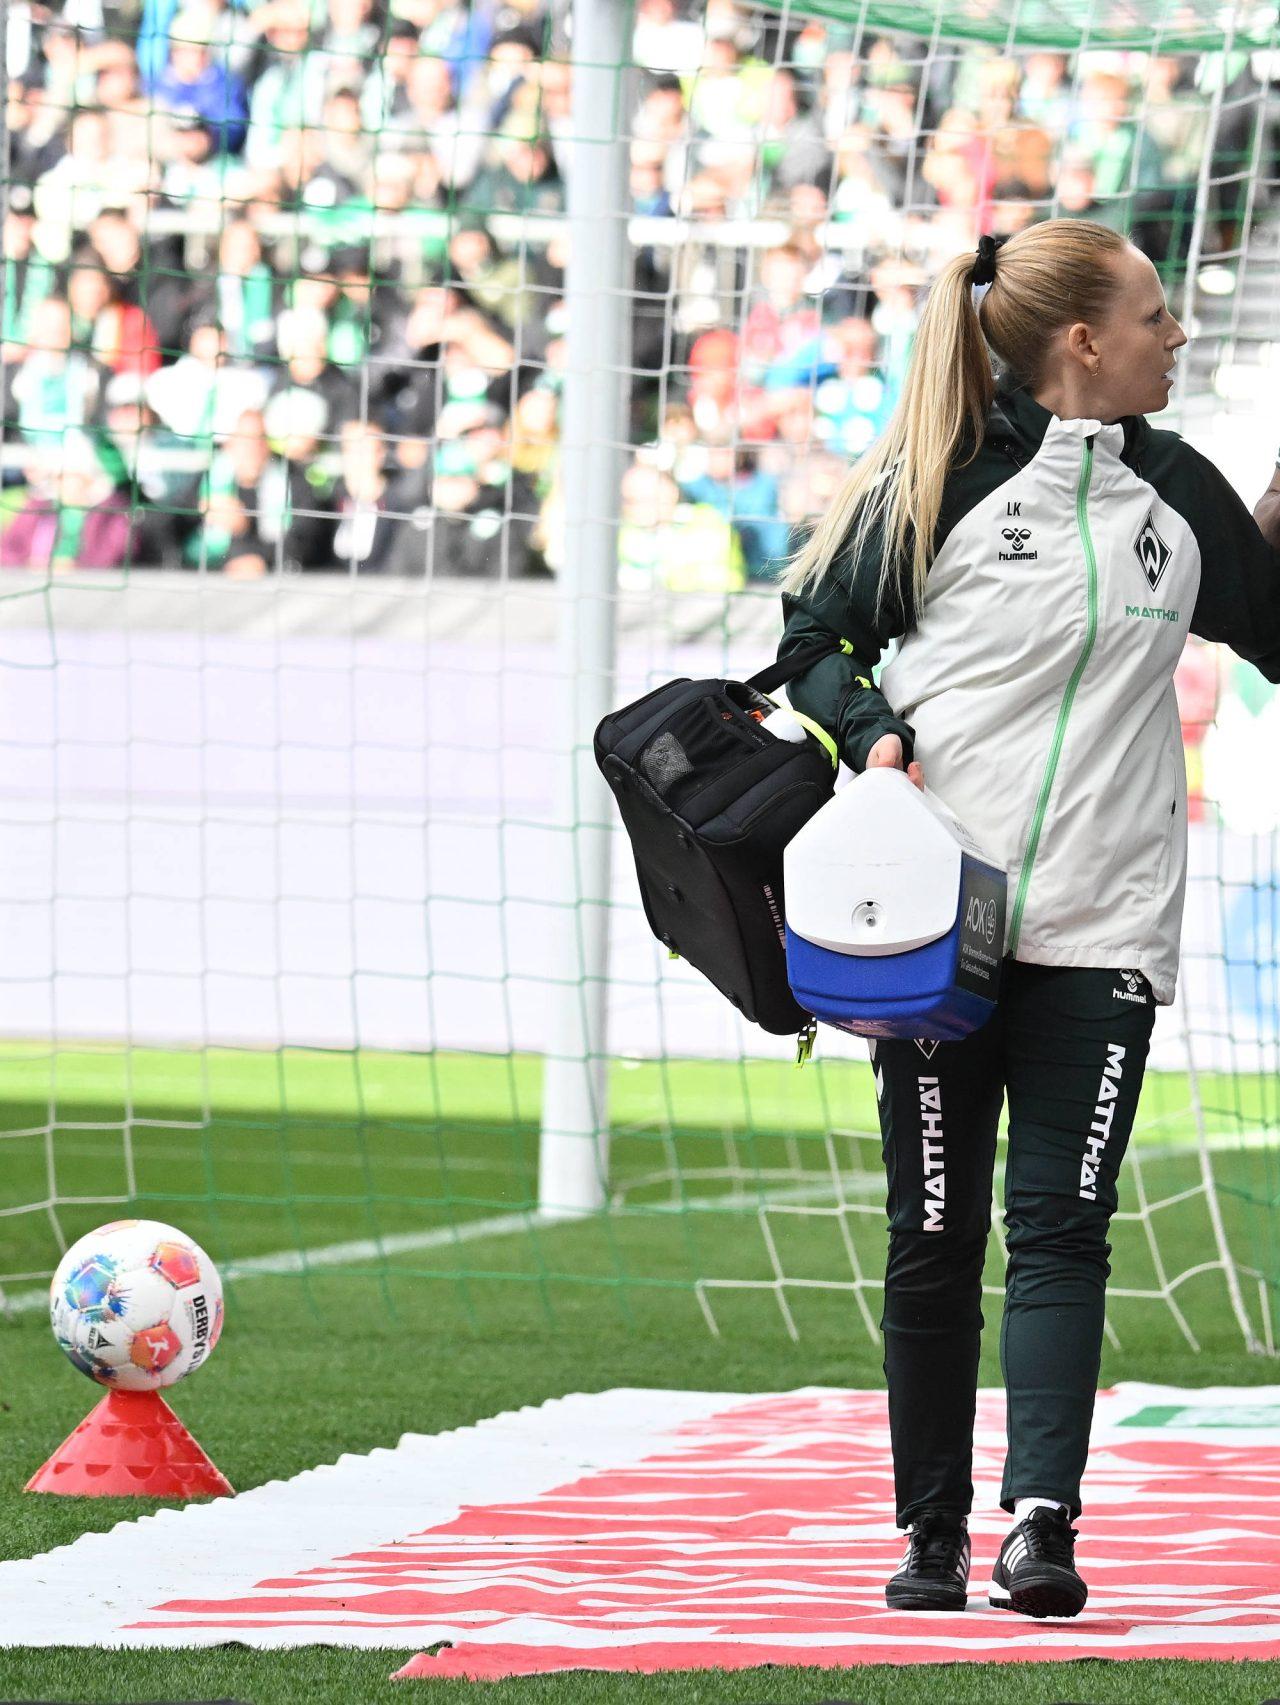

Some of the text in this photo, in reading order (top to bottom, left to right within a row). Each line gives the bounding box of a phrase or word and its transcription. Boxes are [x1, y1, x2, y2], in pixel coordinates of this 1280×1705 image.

[1007, 501, 1021, 516] LK
[998, 550, 1038, 561] hummel
[1125, 605, 1179, 622] MATTHÄI
[965, 896, 987, 935] AOK
[1112, 987, 1147, 1004] hummel
[1079, 1043, 1127, 1201] MATTHÄI
[918, 1076, 945, 1232] MATTHÄI
